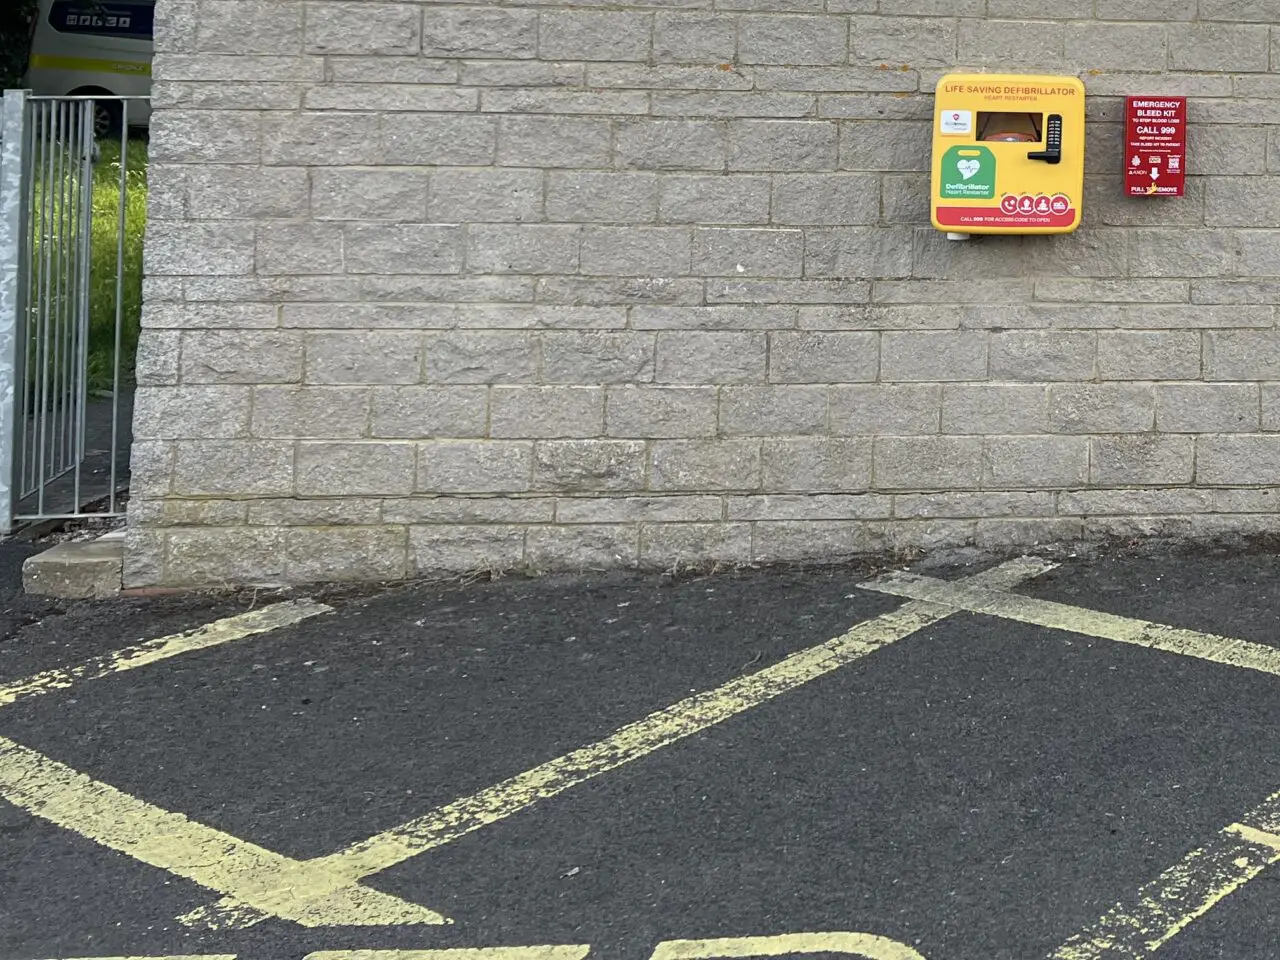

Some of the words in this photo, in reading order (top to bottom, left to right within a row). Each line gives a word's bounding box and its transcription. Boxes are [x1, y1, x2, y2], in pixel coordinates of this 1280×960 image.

[945, 85, 964, 93] LIFE
[967, 86, 1000, 94] SAVING
[1004, 87, 1075, 95] DEFIBRILLATOR
